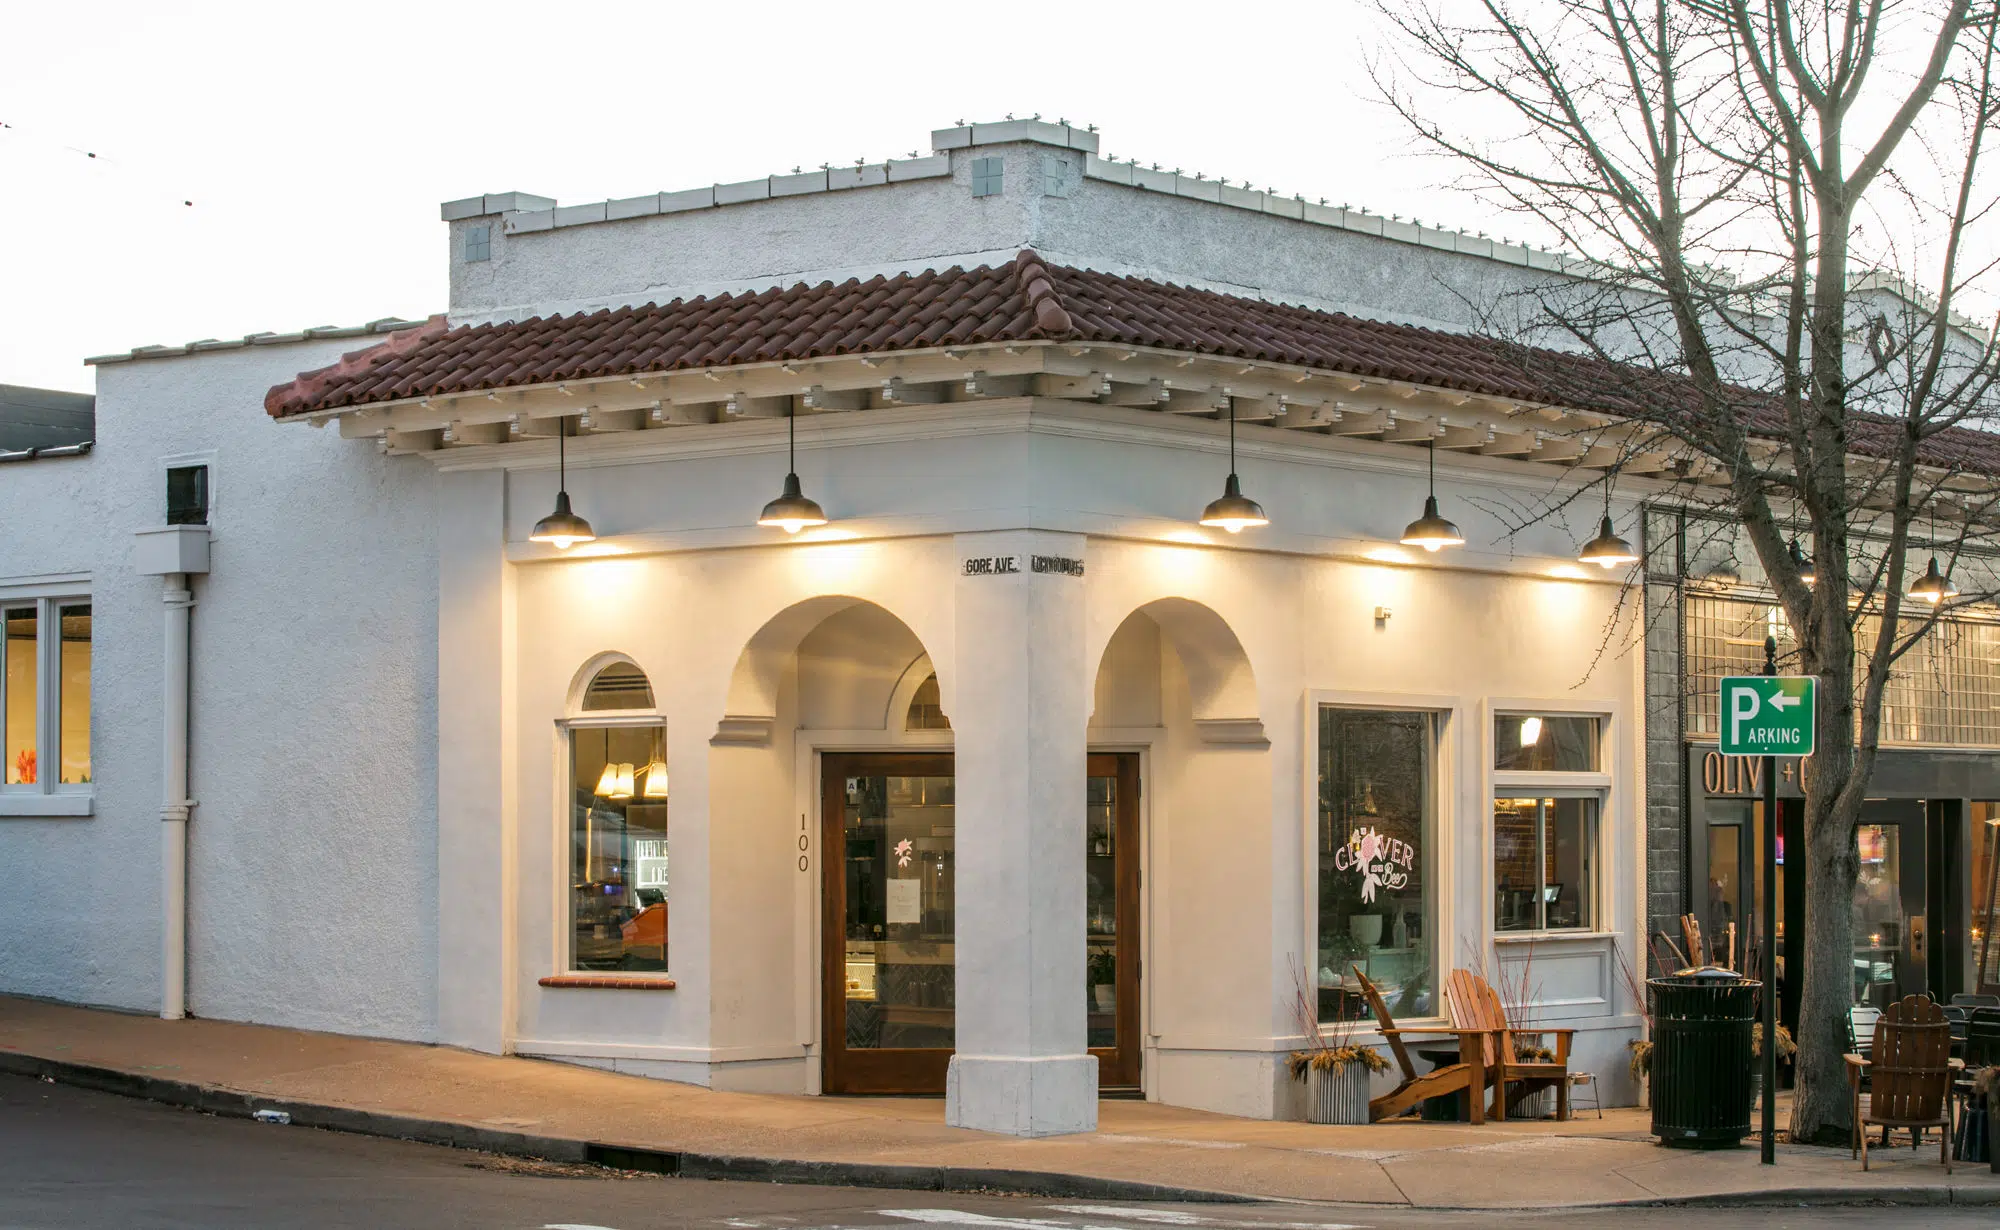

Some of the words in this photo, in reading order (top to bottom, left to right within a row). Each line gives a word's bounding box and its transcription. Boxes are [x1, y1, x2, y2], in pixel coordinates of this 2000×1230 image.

[966, 558, 992, 573] GORE
[995, 557, 1017, 573] AVE.
[1705, 752, 1763, 793] OLIV
[798, 814, 809, 872] 100
[1335, 836, 1414, 871] CLVER
[1382, 862, 1408, 889] Bee
